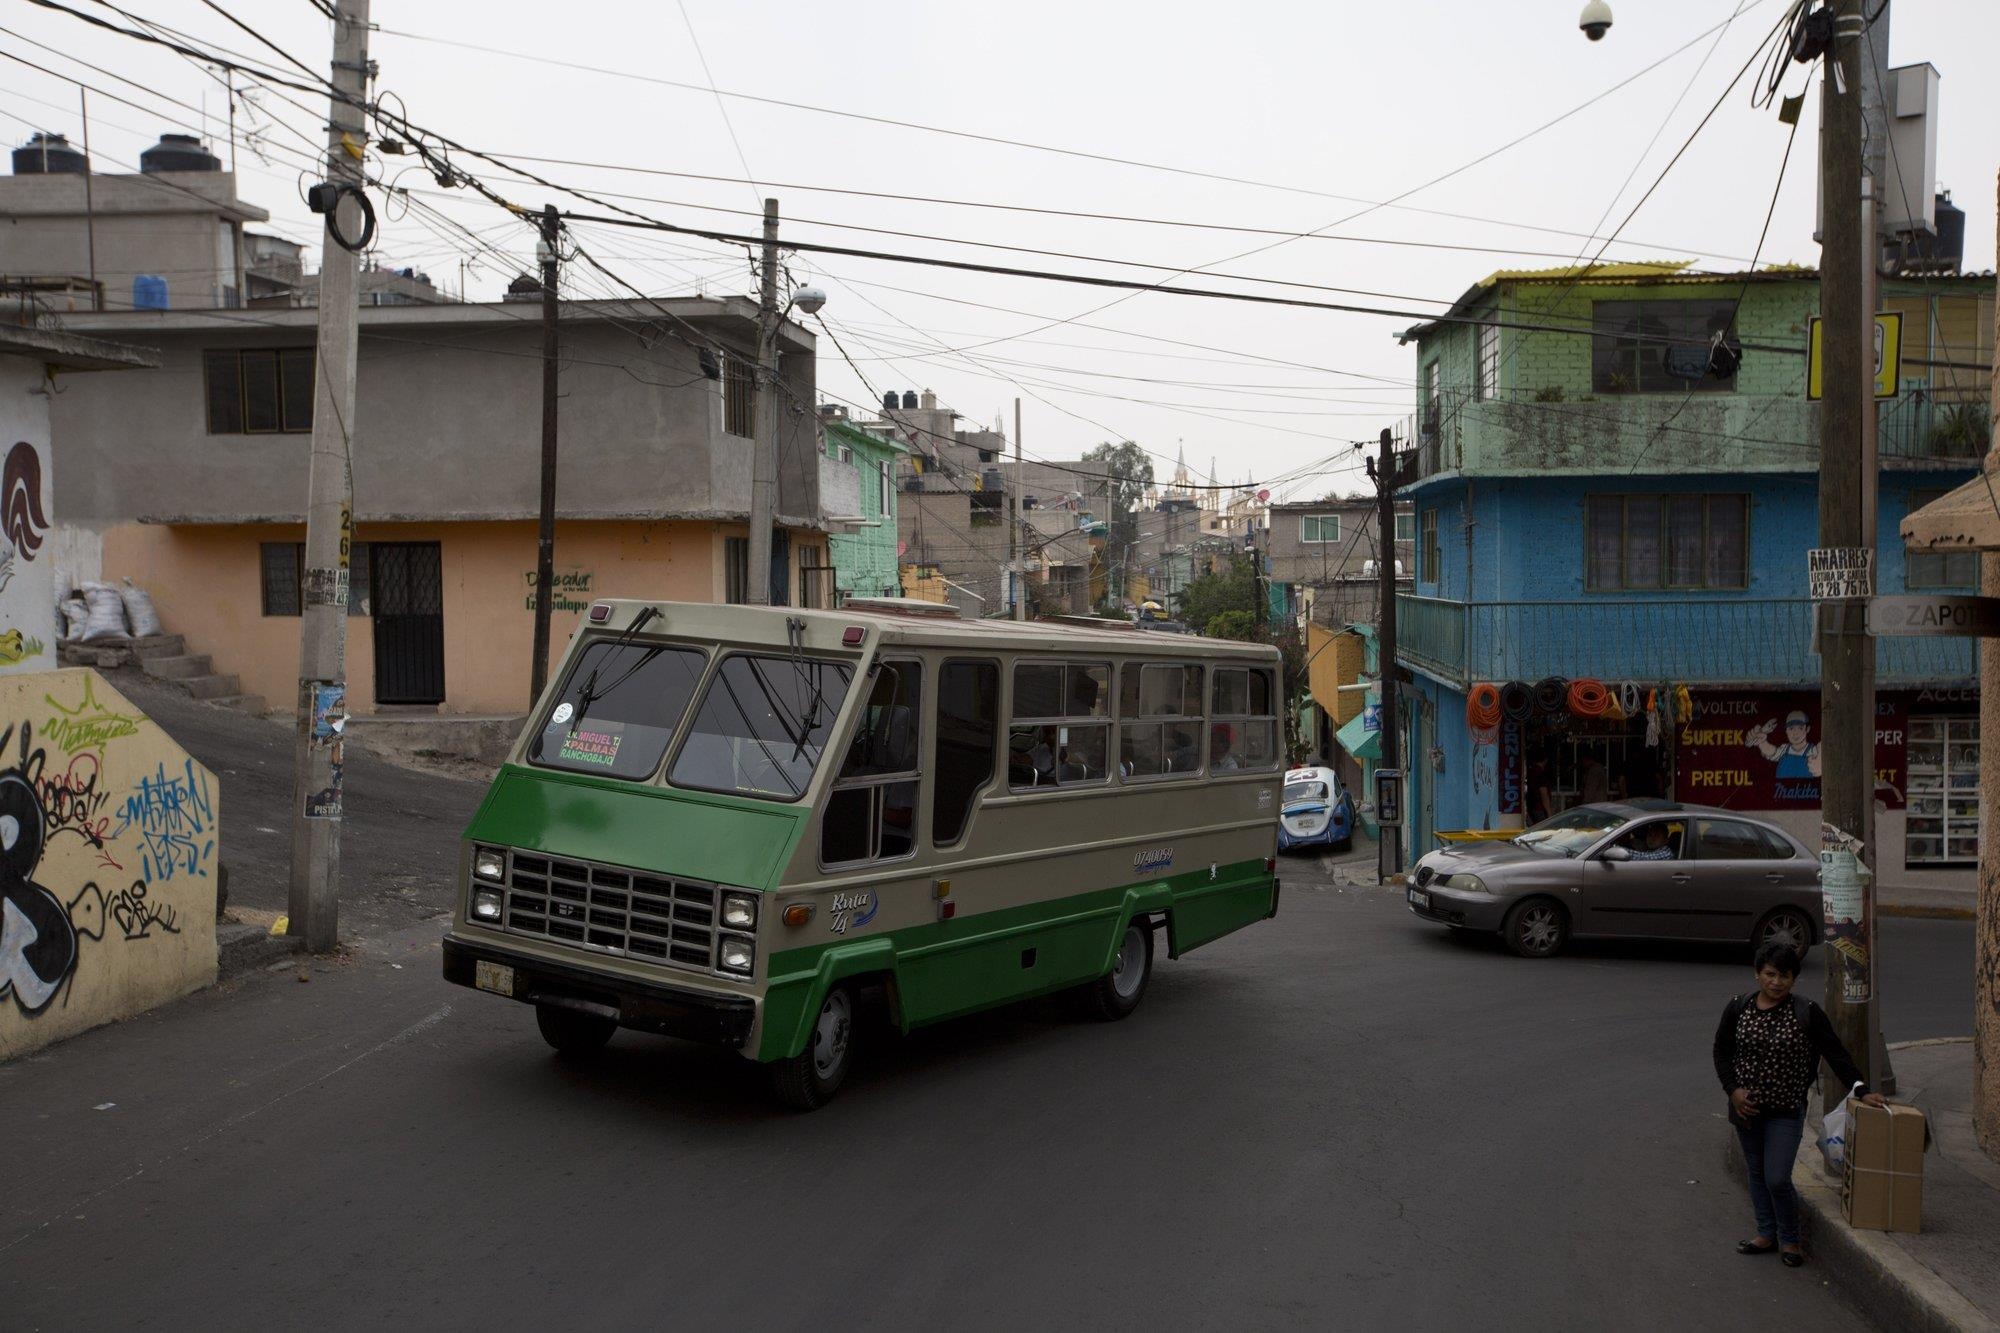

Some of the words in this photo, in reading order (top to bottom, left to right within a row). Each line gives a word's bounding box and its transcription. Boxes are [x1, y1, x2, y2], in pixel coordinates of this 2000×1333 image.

[1810, 549, 1869, 571] AMARRES
[526, 571, 561, 587] De
[1812, 582, 1824, 597] 43
[1826, 581, 1841, 596] 28
[1700, 700, 1759, 714] VOLTECK
[578, 731, 612, 745] MIGUEL
[1682, 729, 1744, 746] SURTEK
[1875, 730, 1903, 745] PER
[570, 741, 616, 756] PALMAS
[1504, 721, 1520, 813] ORNILLOS
[1691, 769, 1754, 787] PRETUL
[831, 893, 869, 912] Ruta
[831, 911, 848, 934] 74
